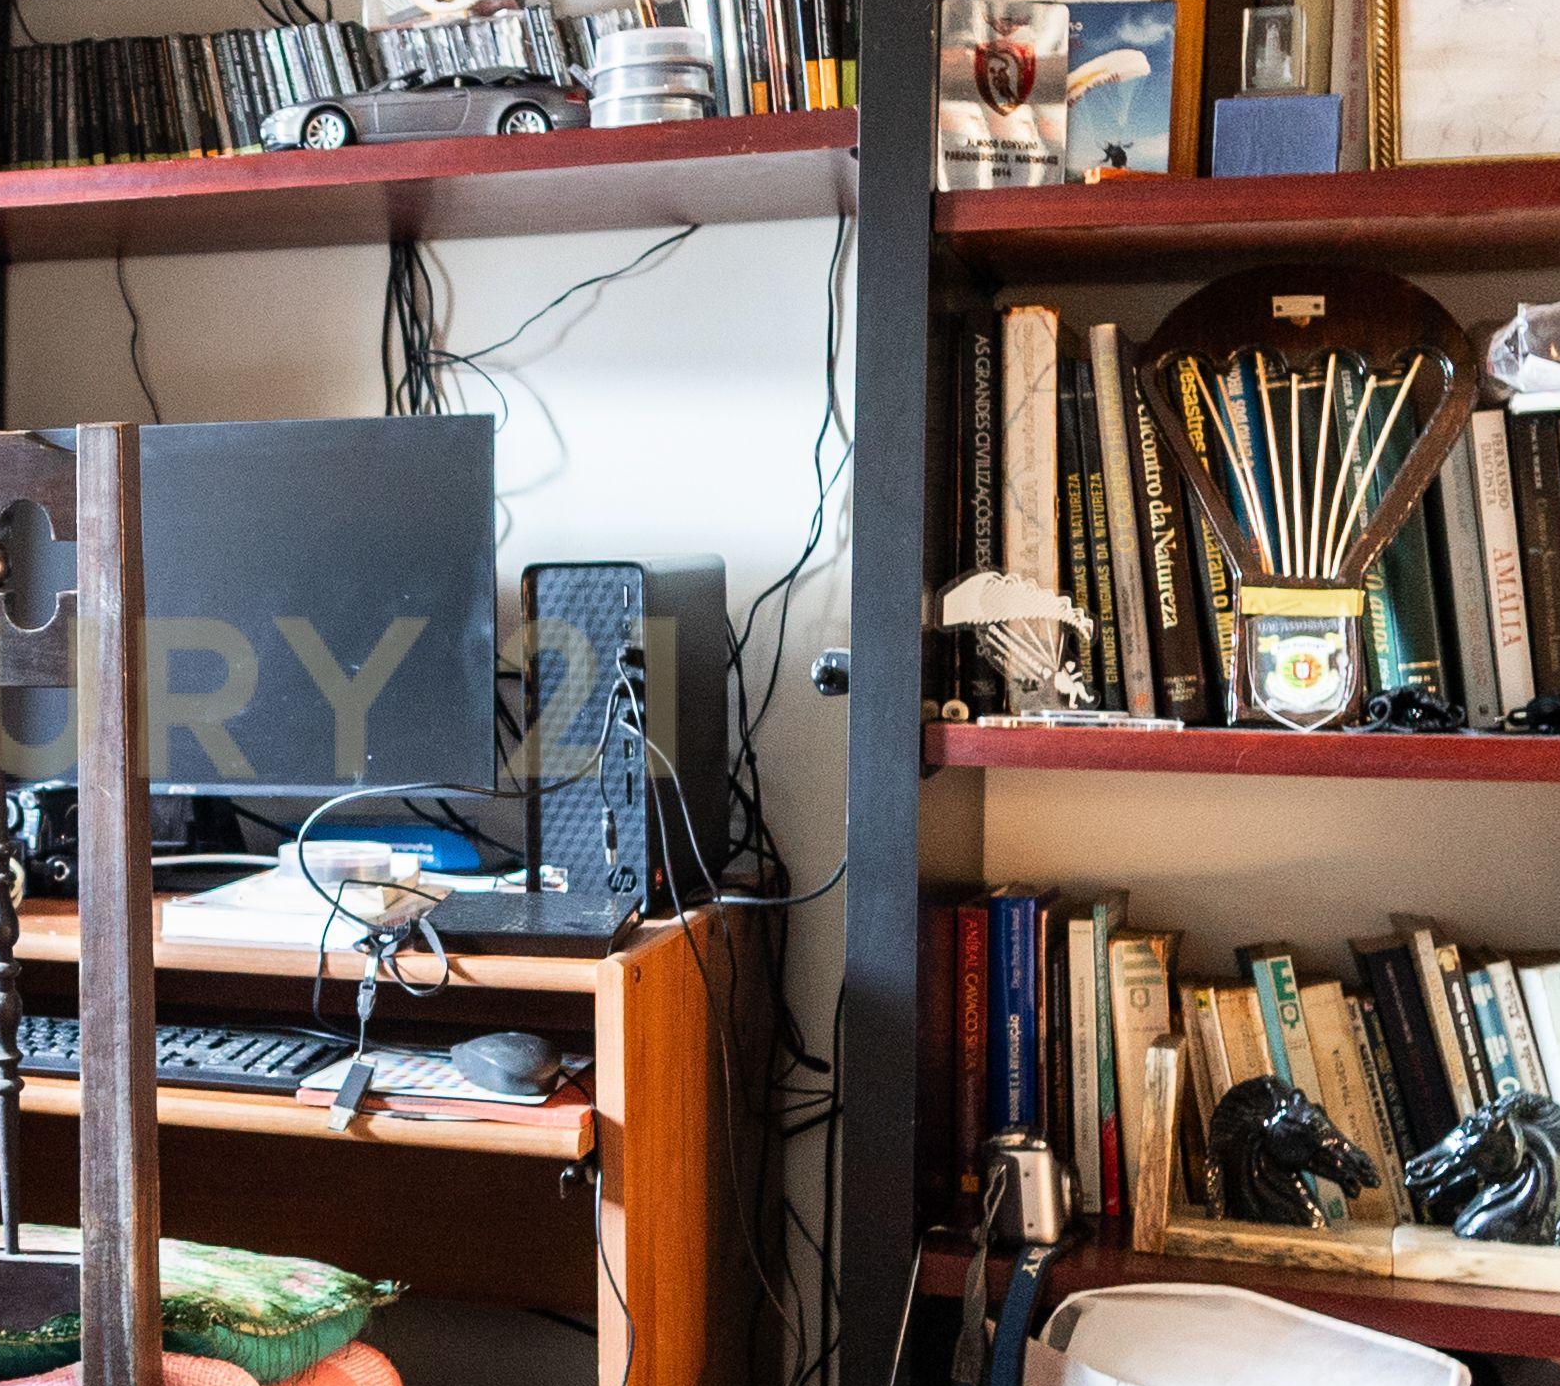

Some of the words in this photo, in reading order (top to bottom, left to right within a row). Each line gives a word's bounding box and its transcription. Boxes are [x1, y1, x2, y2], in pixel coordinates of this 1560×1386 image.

[975, 335, 990, 355] AS
[975, 358, 990, 429] GRANDES
[971, 432, 992, 536] CIVILIZAÇÕES
[1480, 443, 1496, 506] DACOSTA
[1491, 433, 1509, 510] FERNANDO
[1068, 472, 1084, 537] NATUREZA
[1089, 472, 1107, 537] NATUREZA
[1149, 501, 1172, 527] da
[1073, 543, 1086, 559] DA
[1095, 543, 1109, 559] DA
[1154, 529, 1179, 629] Natureza
[1098, 565, 1114, 621] ENIGMAS
[1492, 548, 1522, 647] AMÁLIA
[1370, 595, 1388, 653] anos
[1101, 626, 1118, 683] GRANDES
[609, 865, 635, 895] hp
[965, 919, 981, 970] ANÍBAL
[965, 973, 977, 1033] CAVACO
[965, 1036, 977, 1070] SILVA
[1520, 1044, 1541, 1093] ornada
